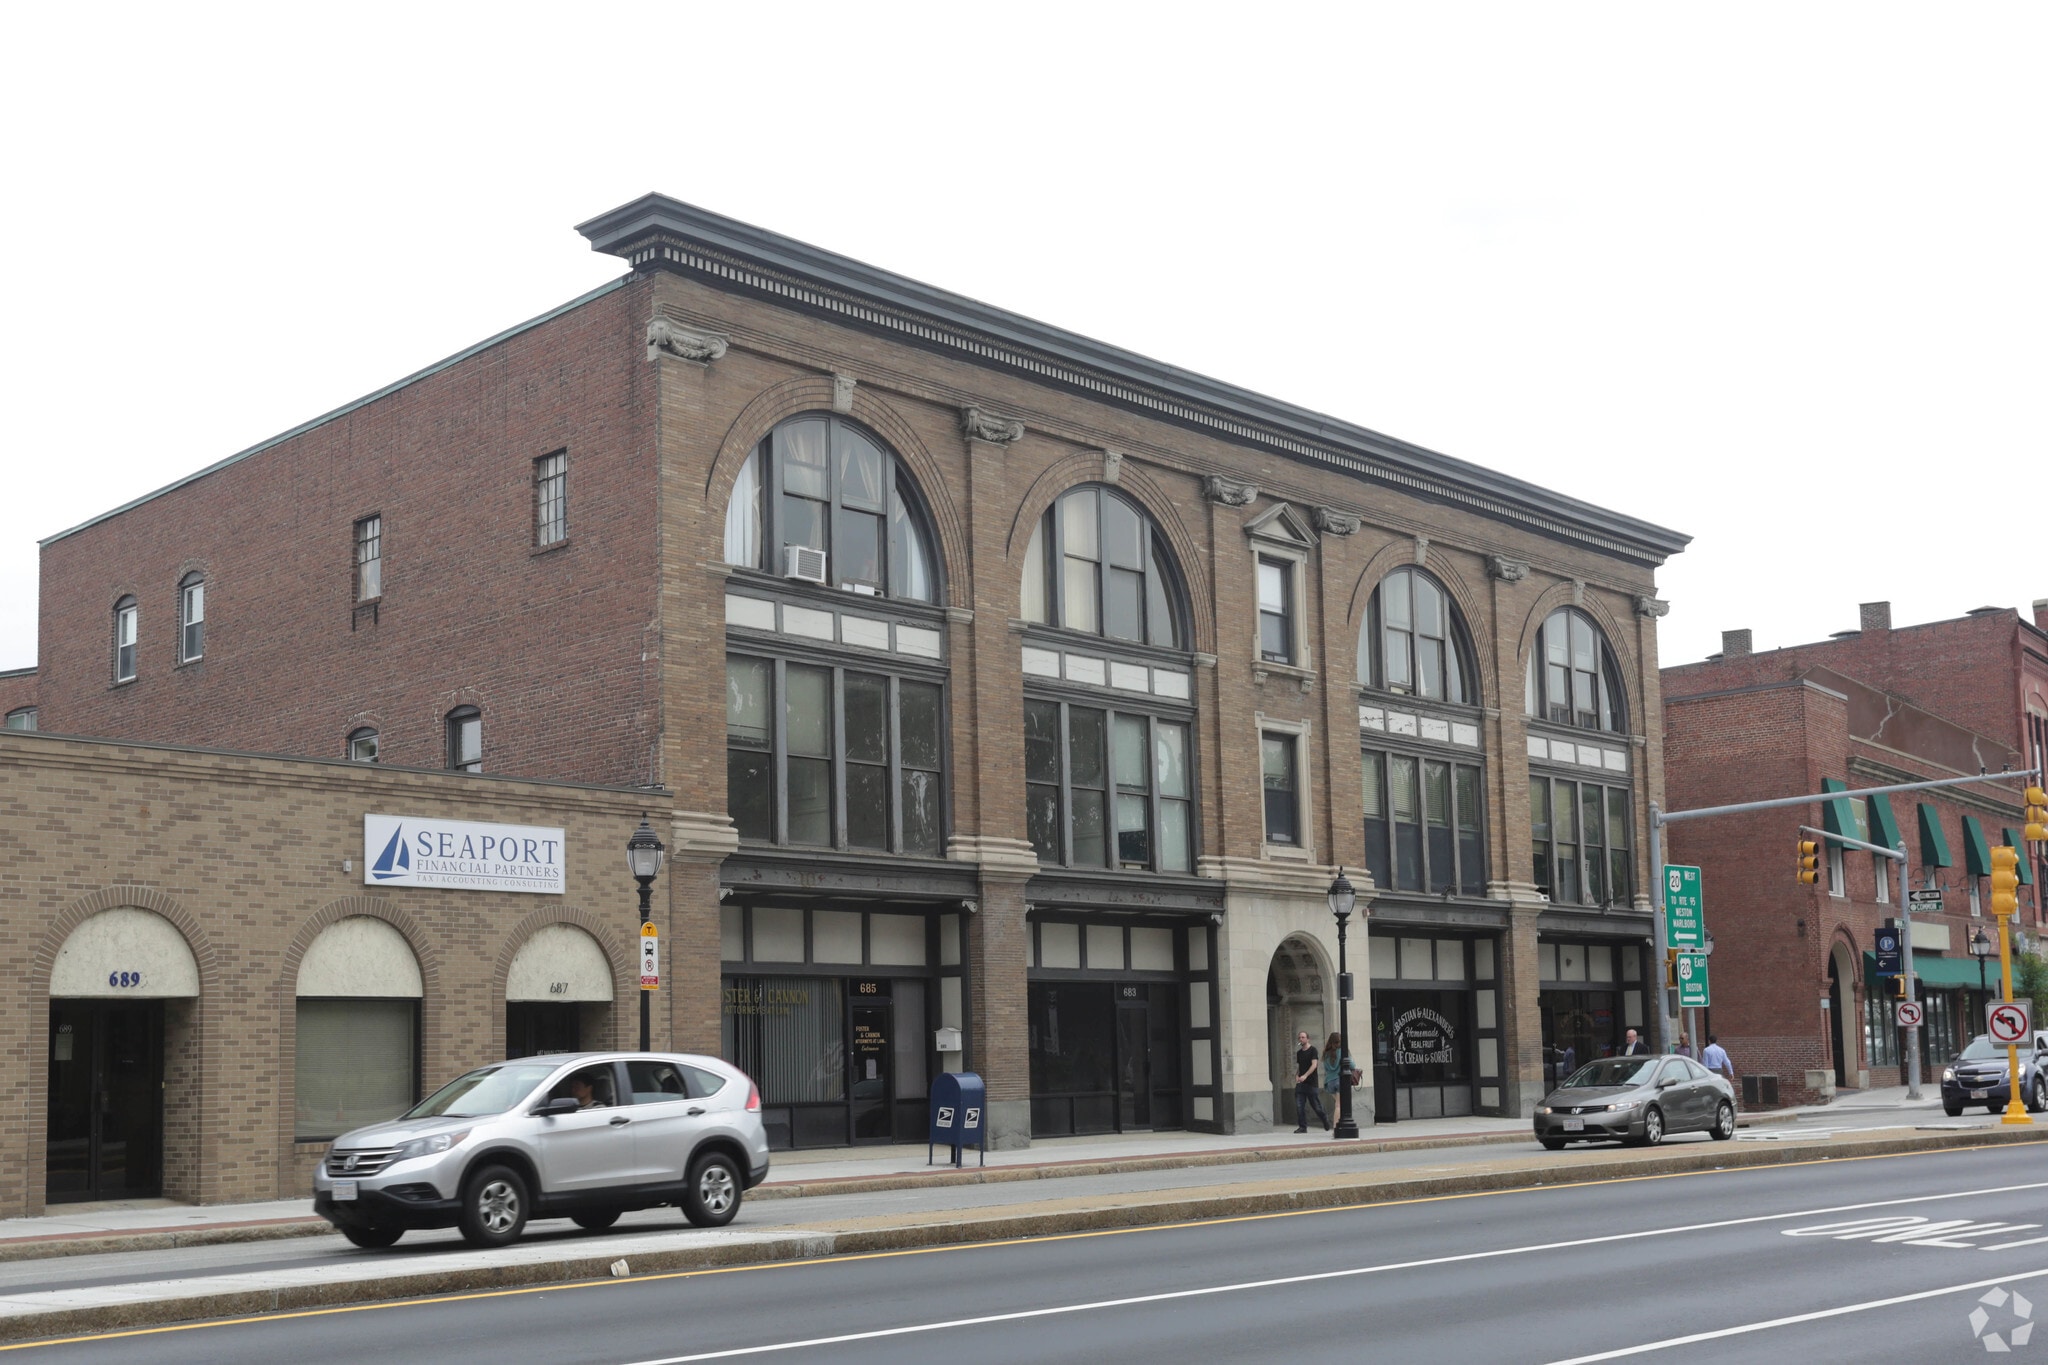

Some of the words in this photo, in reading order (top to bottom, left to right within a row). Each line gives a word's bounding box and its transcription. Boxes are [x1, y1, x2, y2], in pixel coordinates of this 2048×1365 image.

[417, 831, 558, 865] SEAPORT
[417, 859, 490, 874] FINANCIAL
[495, 864, 559, 878] PARTNERS
[417, 874, 433, 882] TAX
[441, 876, 498, 886] ACCOUNTING
[504, 880, 559, 889] CONSULTING
[1671, 875, 1680, 888] 20
[1684, 870, 1696, 881] WEST
[1671, 895, 1677, 905] TO
[1690, 896, 1696, 906] 95
[1675, 907, 1693, 917] WESTON
[1673, 919, 1696, 929] MARLBORO
[1682, 963, 1690, 976] 20
[1694, 957, 1705, 968] EAST
[109, 971, 140, 988] 689
[550, 982, 568, 994] 687
[860, 983, 877, 994] 685
[1123, 987, 1137, 997] 683
[1685, 983, 1703, 992] BOSTON
[721, 988, 751, 1003] OSTER
[768, 989, 808, 1004] CANNON
[1405, 1026, 1439, 1038] Homemade
[1405, 1051, 1424, 1065] CREAM
